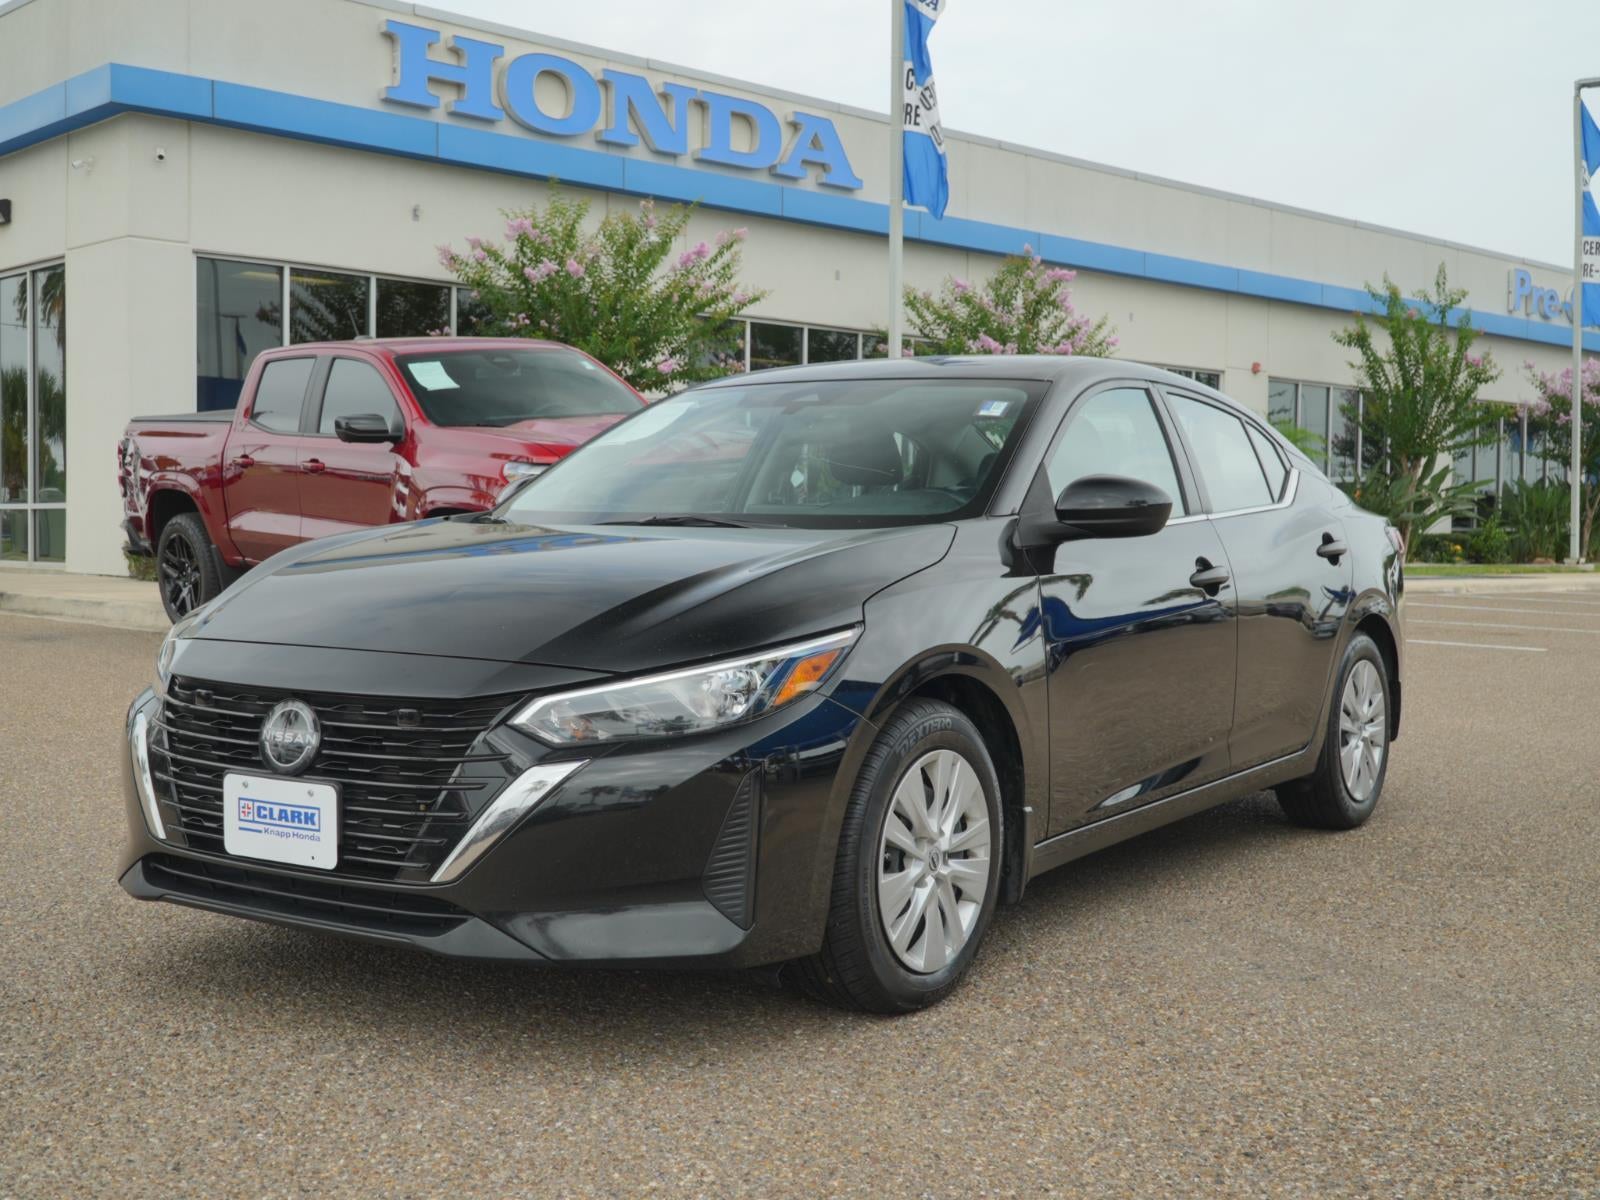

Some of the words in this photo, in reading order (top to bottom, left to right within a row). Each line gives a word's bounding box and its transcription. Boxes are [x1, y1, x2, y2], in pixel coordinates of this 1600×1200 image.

[382, 19, 863, 190] HONDA
[1583, 240, 1600, 256] CER
[1509, 268, 1574, 322] Pre-
[262, 729, 317, 745] NISSAN
[256, 805, 316, 826] CLARK
[263, 826, 291, 839] Knapp
[292, 829, 321, 842] Honda
